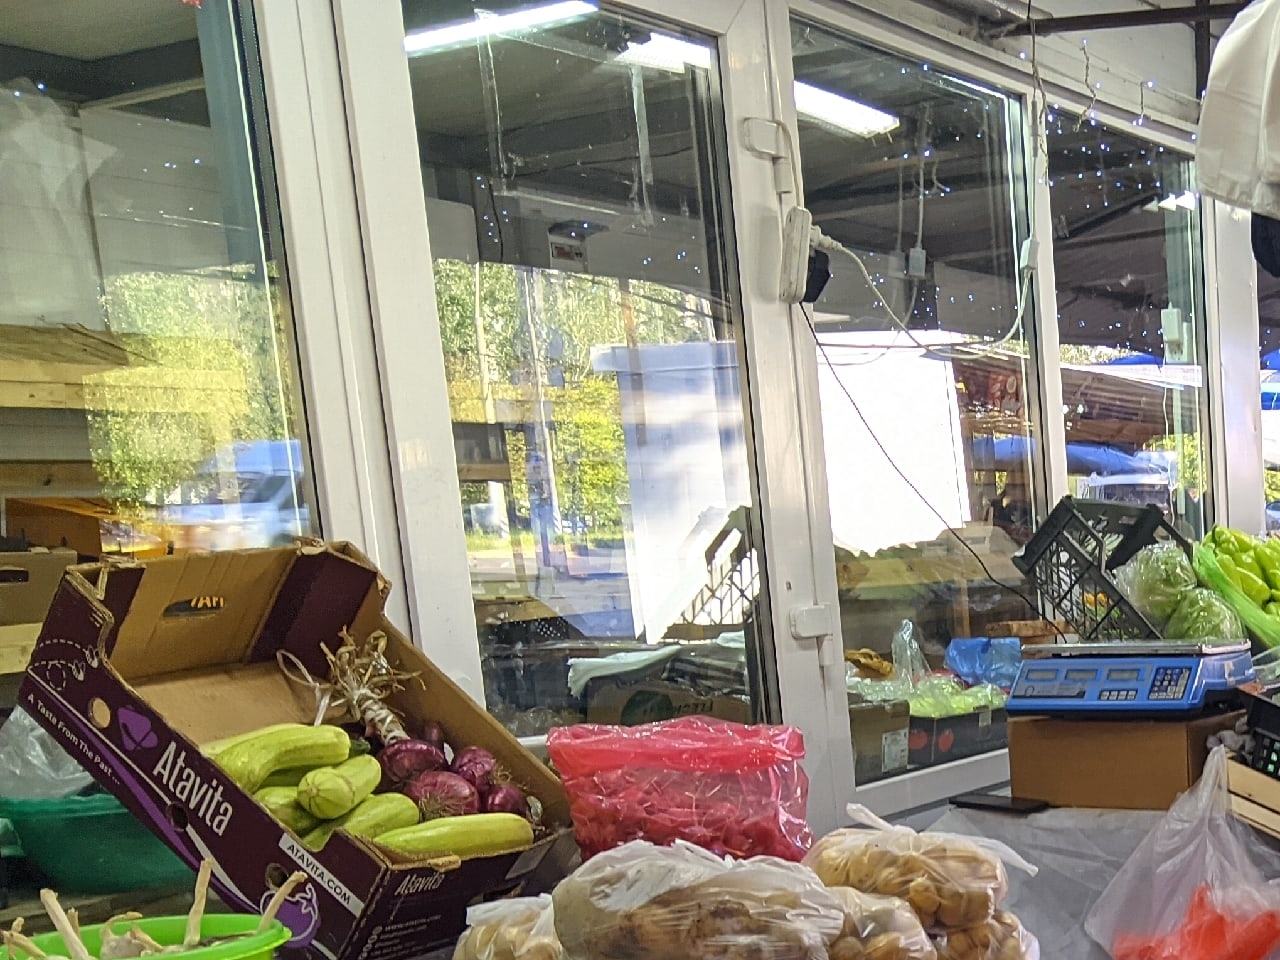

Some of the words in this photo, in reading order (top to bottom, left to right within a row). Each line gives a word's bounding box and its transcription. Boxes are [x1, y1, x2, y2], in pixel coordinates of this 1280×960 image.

[27, 693, 35, 705] A
[37, 699, 57, 727] Taste
[57, 720, 79, 746] From
[79, 739, 94, 761] The
[93, 754, 113, 778] Past
[152, 740, 233, 837] Atavita
[286, 843, 352, 906] ATAVITA.COM
[394, 870, 446, 897] Atavita
